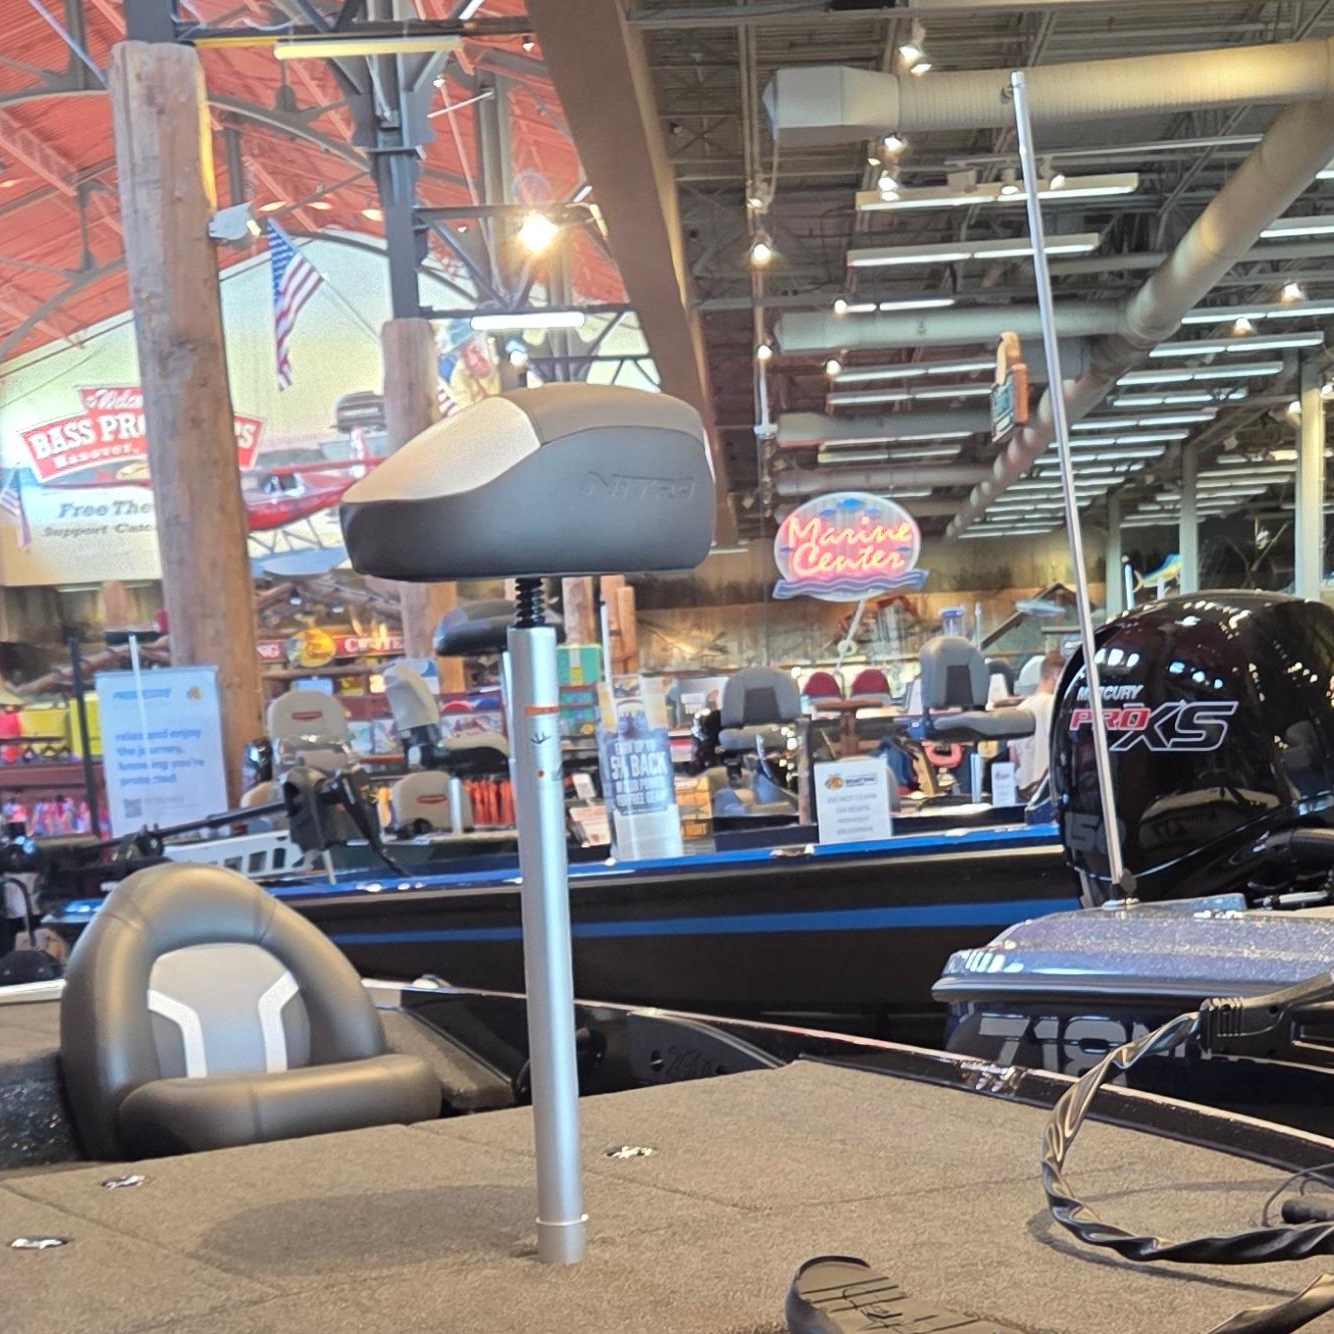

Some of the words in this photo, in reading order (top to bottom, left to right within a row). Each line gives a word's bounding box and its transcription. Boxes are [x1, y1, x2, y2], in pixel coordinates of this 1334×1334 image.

[28, 419, 96, 460] BASS
[58, 502, 108, 518] Free
[787, 515, 913, 549] Marine
[792, 543, 907, 577] Center
[1108, 700, 1240, 752] XS
[630, 751, 668, 777] BACK
